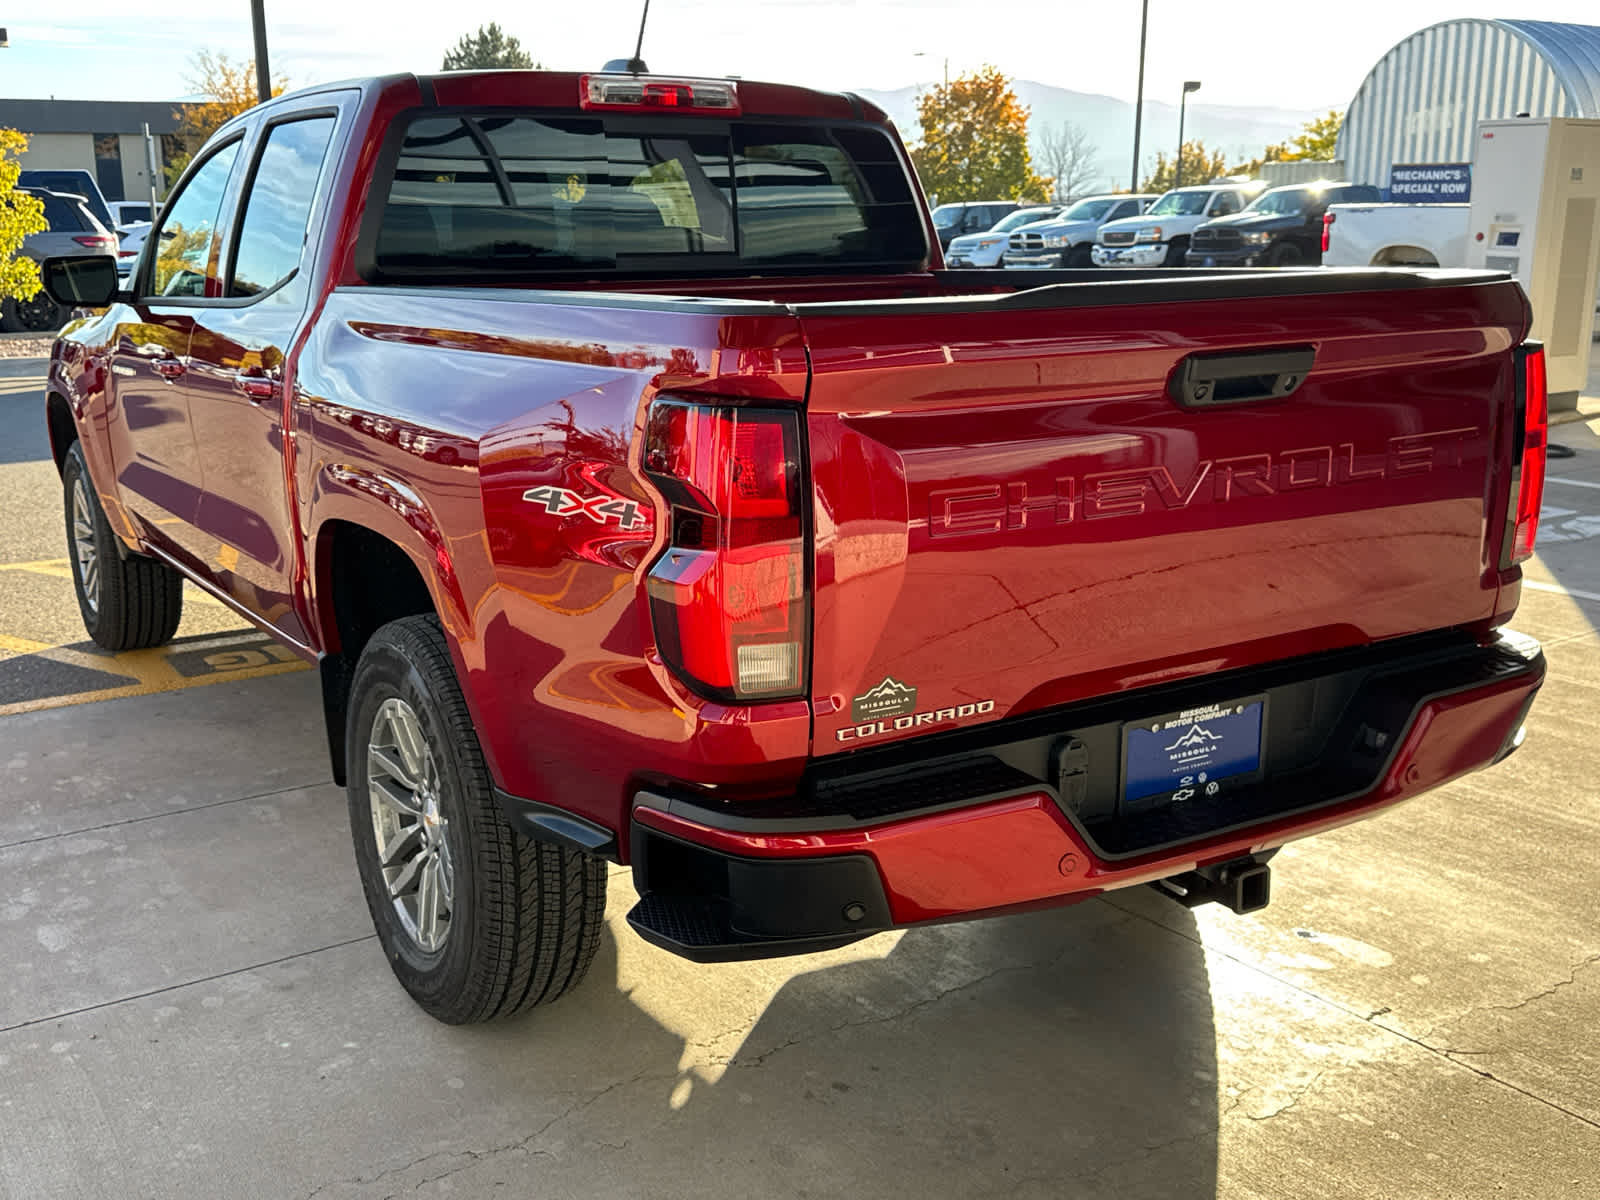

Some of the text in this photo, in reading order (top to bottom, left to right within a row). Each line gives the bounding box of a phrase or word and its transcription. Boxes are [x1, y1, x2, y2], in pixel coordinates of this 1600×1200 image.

[1441, 184, 1466, 193] ROW
[928, 426, 1480, 538] CHEVROLET
[860, 697, 910, 710] MISSOULA
[1180, 704, 1219, 718] MISSOULA
[837, 700, 994, 741] COLORADO
[1165, 708, 1231, 729] MOTOR COMPANY
[1170, 745, 1216, 760] MISSOULA
